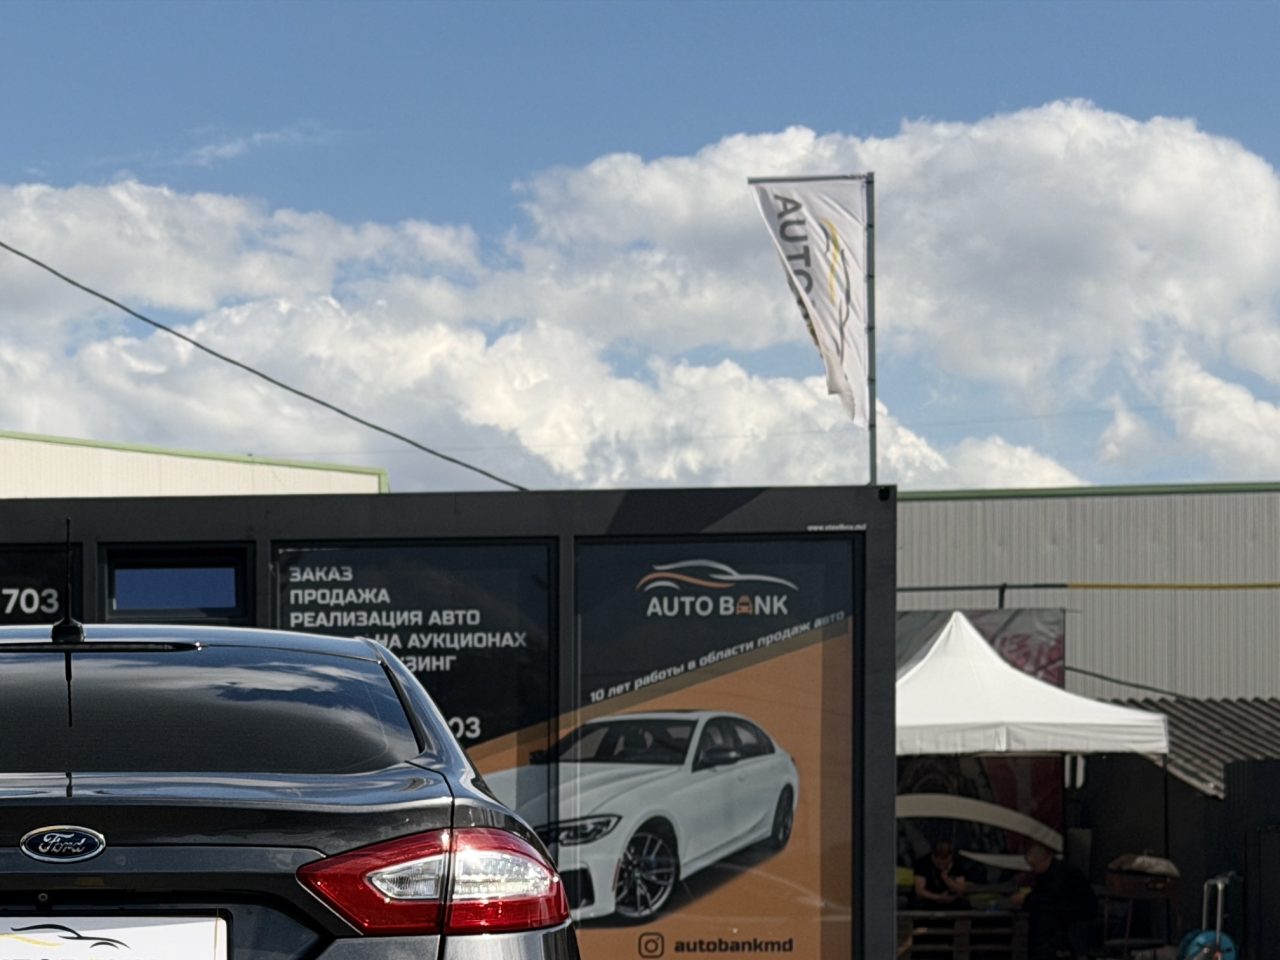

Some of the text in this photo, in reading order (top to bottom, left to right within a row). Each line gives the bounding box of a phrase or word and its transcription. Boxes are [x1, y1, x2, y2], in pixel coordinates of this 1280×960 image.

[289, 566, 353, 582] ЗАКАЗ
[1, 588, 59, 614] 703
[290, 588, 391, 606] ПРОДАЖА
[290, 609, 481, 628] РЕАЛИЗАЦИЯ АВТО
[375, 632, 527, 650] НА АУКЦИОНАХ
[401, 655, 457, 671] ЗИНГ
[590, 611, 845, 703] 10 лет работы в области продаж авто
[38, 833, 86, 853] Ford
[674, 937, 794, 953] autobankmd
